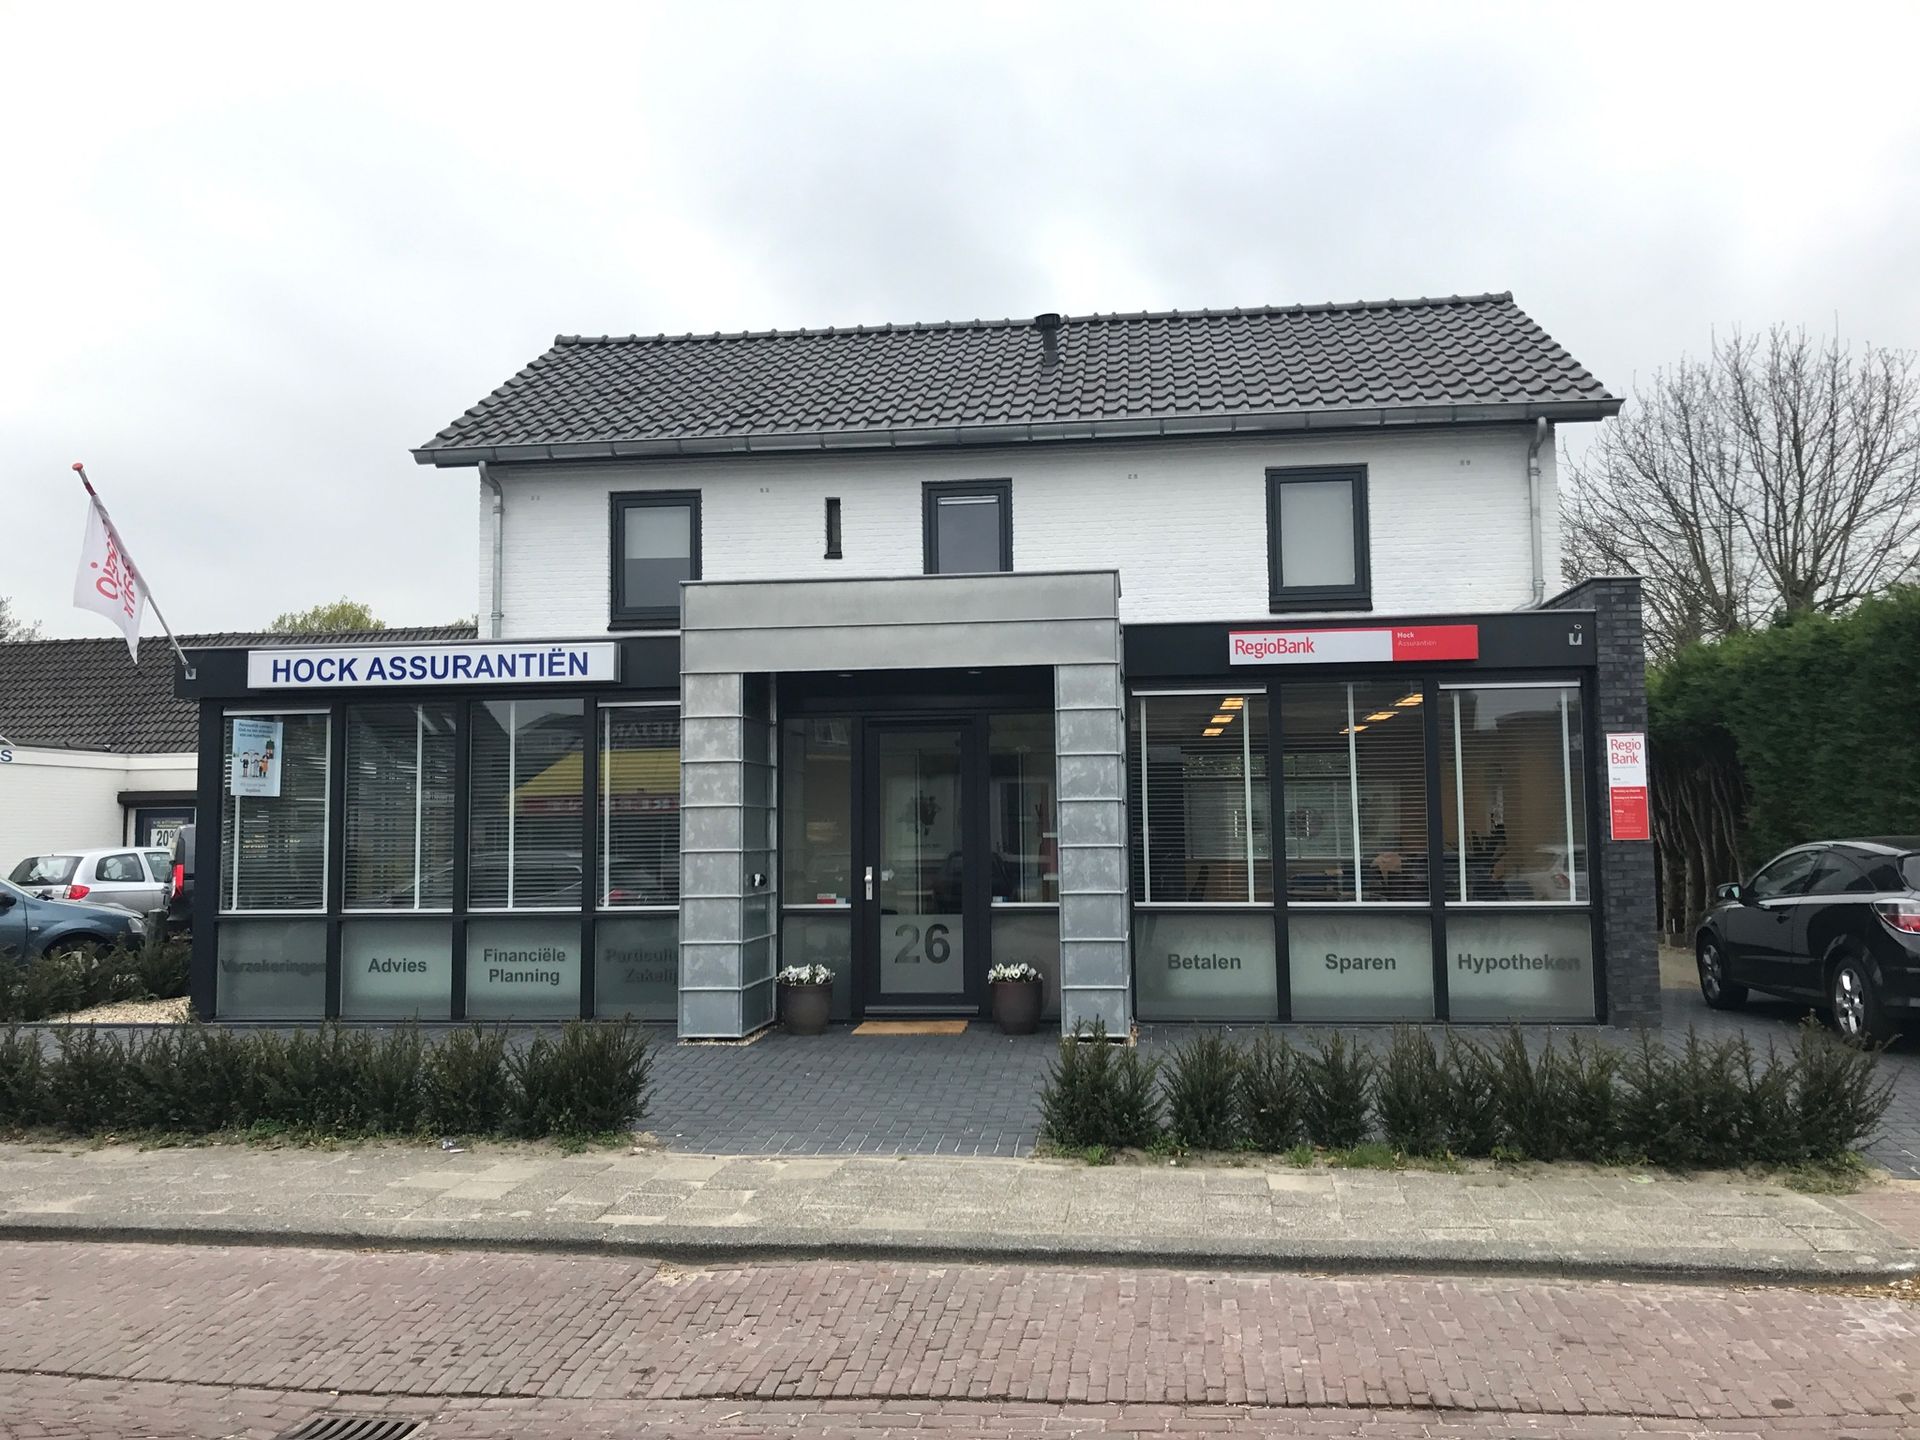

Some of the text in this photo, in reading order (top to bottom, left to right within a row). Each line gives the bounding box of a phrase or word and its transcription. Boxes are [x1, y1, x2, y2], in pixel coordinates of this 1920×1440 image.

[1397, 631, 1415, 639] Hock
[1235, 637, 1315, 659] RegioBank
[272, 648, 589, 683] HOCK ASSURANTIËN
[1610, 738, 1642, 753] Regio
[1611, 752, 1639, 764] Bank
[894, 924, 950, 963] 26
[483, 948, 566, 962] Financiële
[1168, 954, 1241, 970] Betalen
[1325, 953, 1397, 974] Sparen
[1458, 953, 1581, 974] Hypotheken
[368, 958, 427, 973] Advies
[489, 968, 560, 986] Planning
